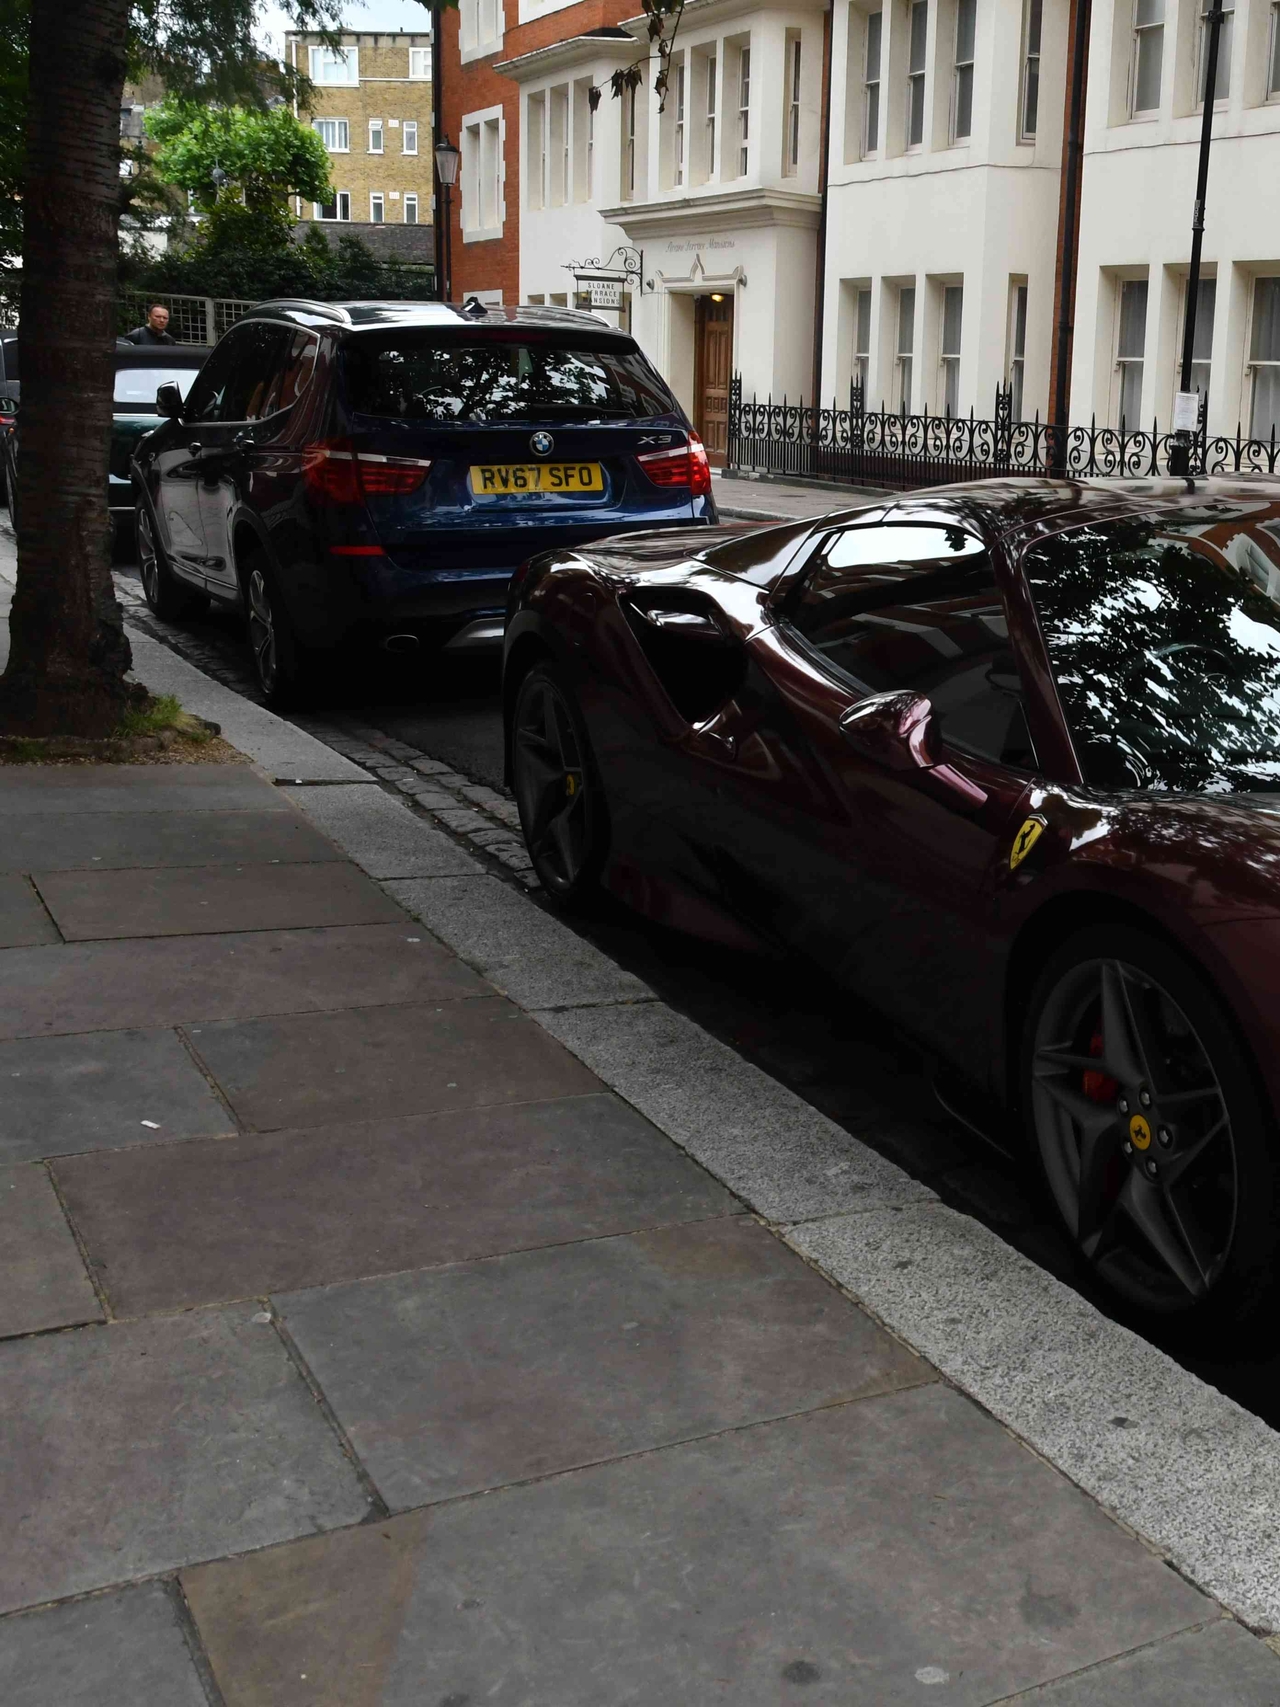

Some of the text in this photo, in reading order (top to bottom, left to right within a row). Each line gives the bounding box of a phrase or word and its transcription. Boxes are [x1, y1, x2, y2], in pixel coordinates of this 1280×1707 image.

[587, 282, 615, 290] SLOANE
[637, 435, 672, 444] X3
[480, 466, 593, 490] RV67 SFO
